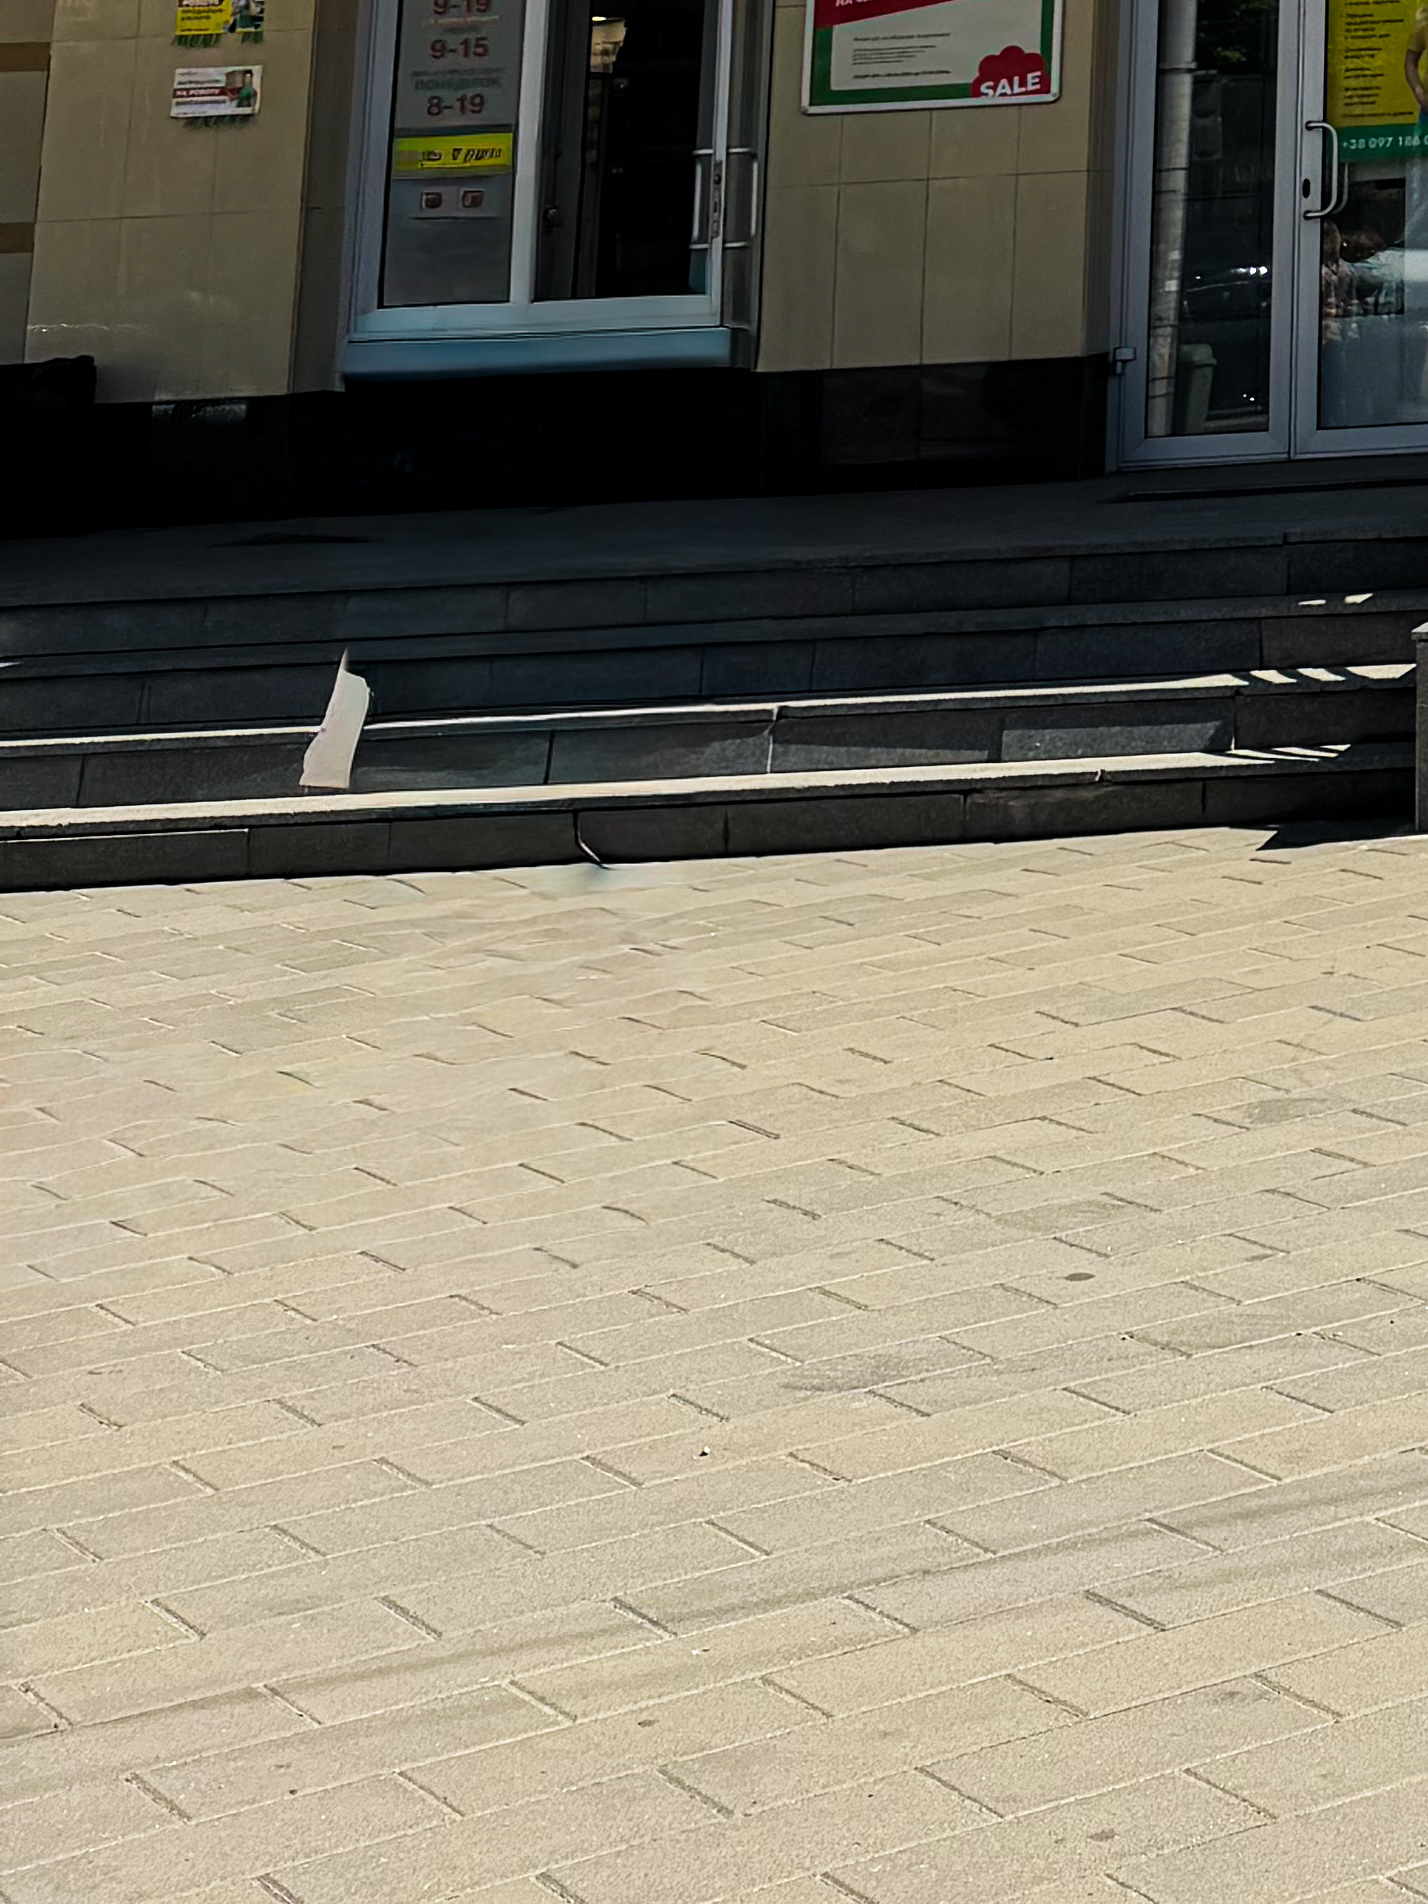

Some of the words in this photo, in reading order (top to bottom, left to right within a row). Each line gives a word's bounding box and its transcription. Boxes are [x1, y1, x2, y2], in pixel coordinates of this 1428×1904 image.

[429, 36, 490, 60] 9-15
[979, 70, 1043, 98] SALE
[426, 92, 486, 117] 8-19
